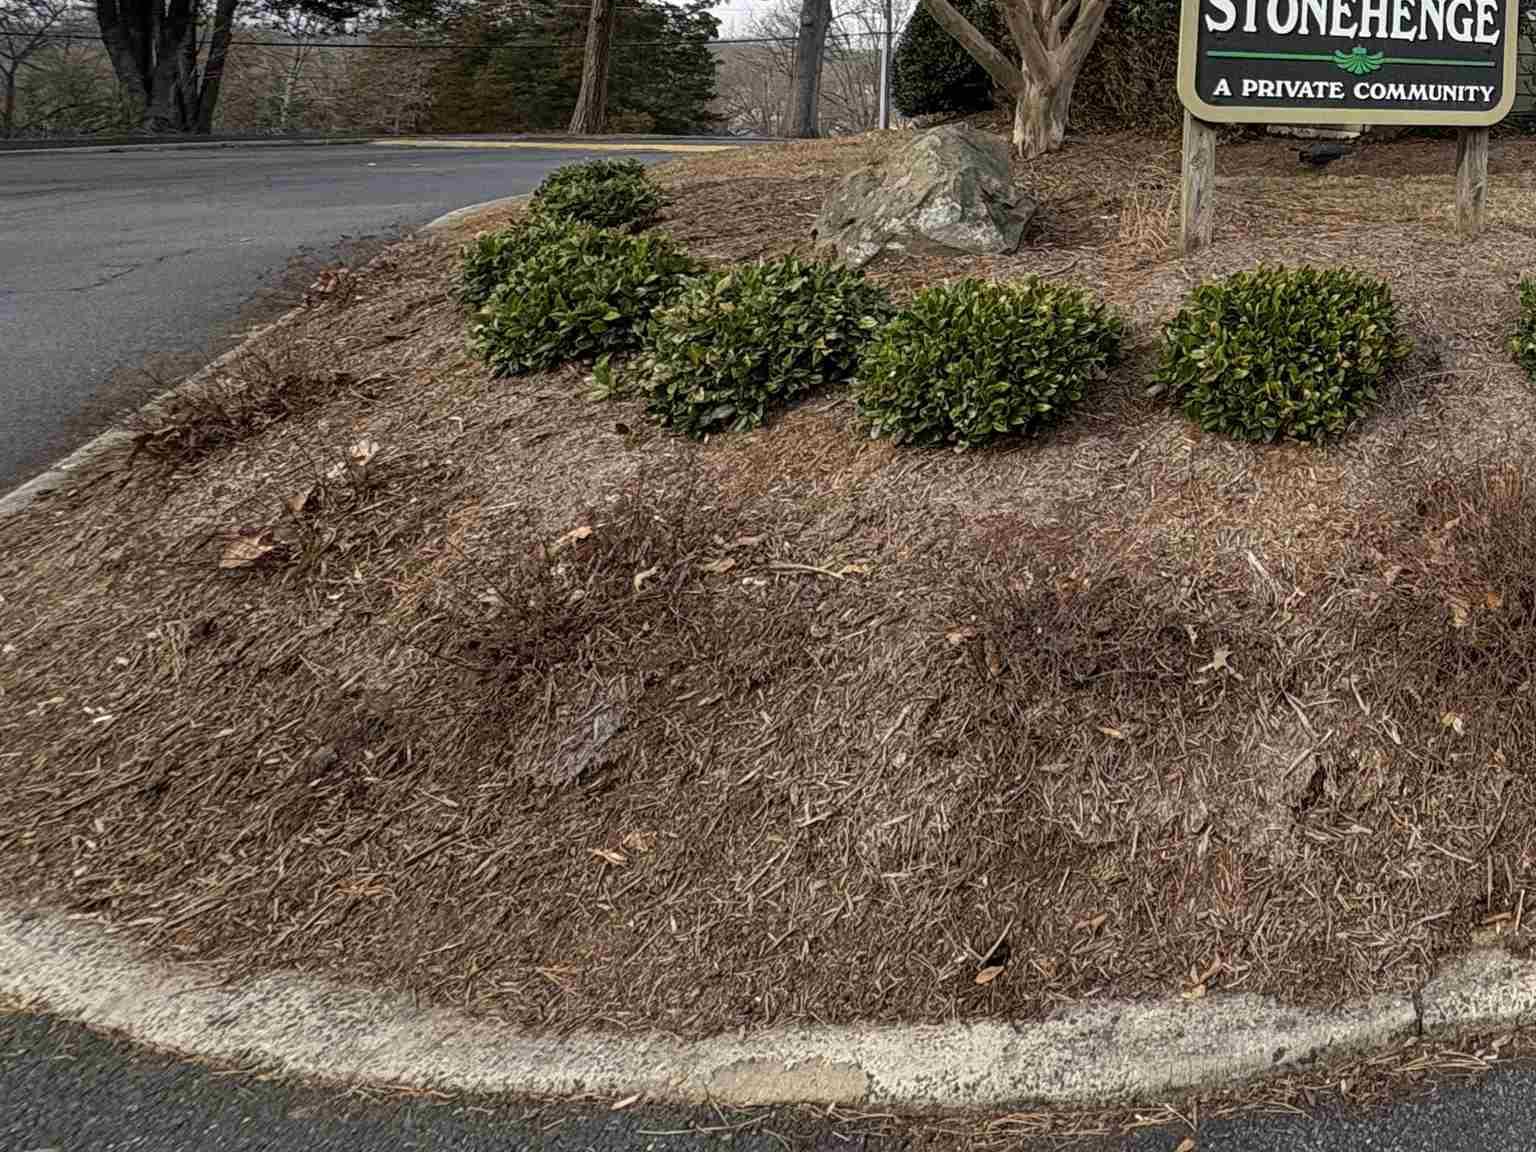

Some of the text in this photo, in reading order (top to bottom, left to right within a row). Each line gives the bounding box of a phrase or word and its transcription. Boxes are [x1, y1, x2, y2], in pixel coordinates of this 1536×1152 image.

[1213, 78, 1494, 102] A PRIVATE COMMUNITY
